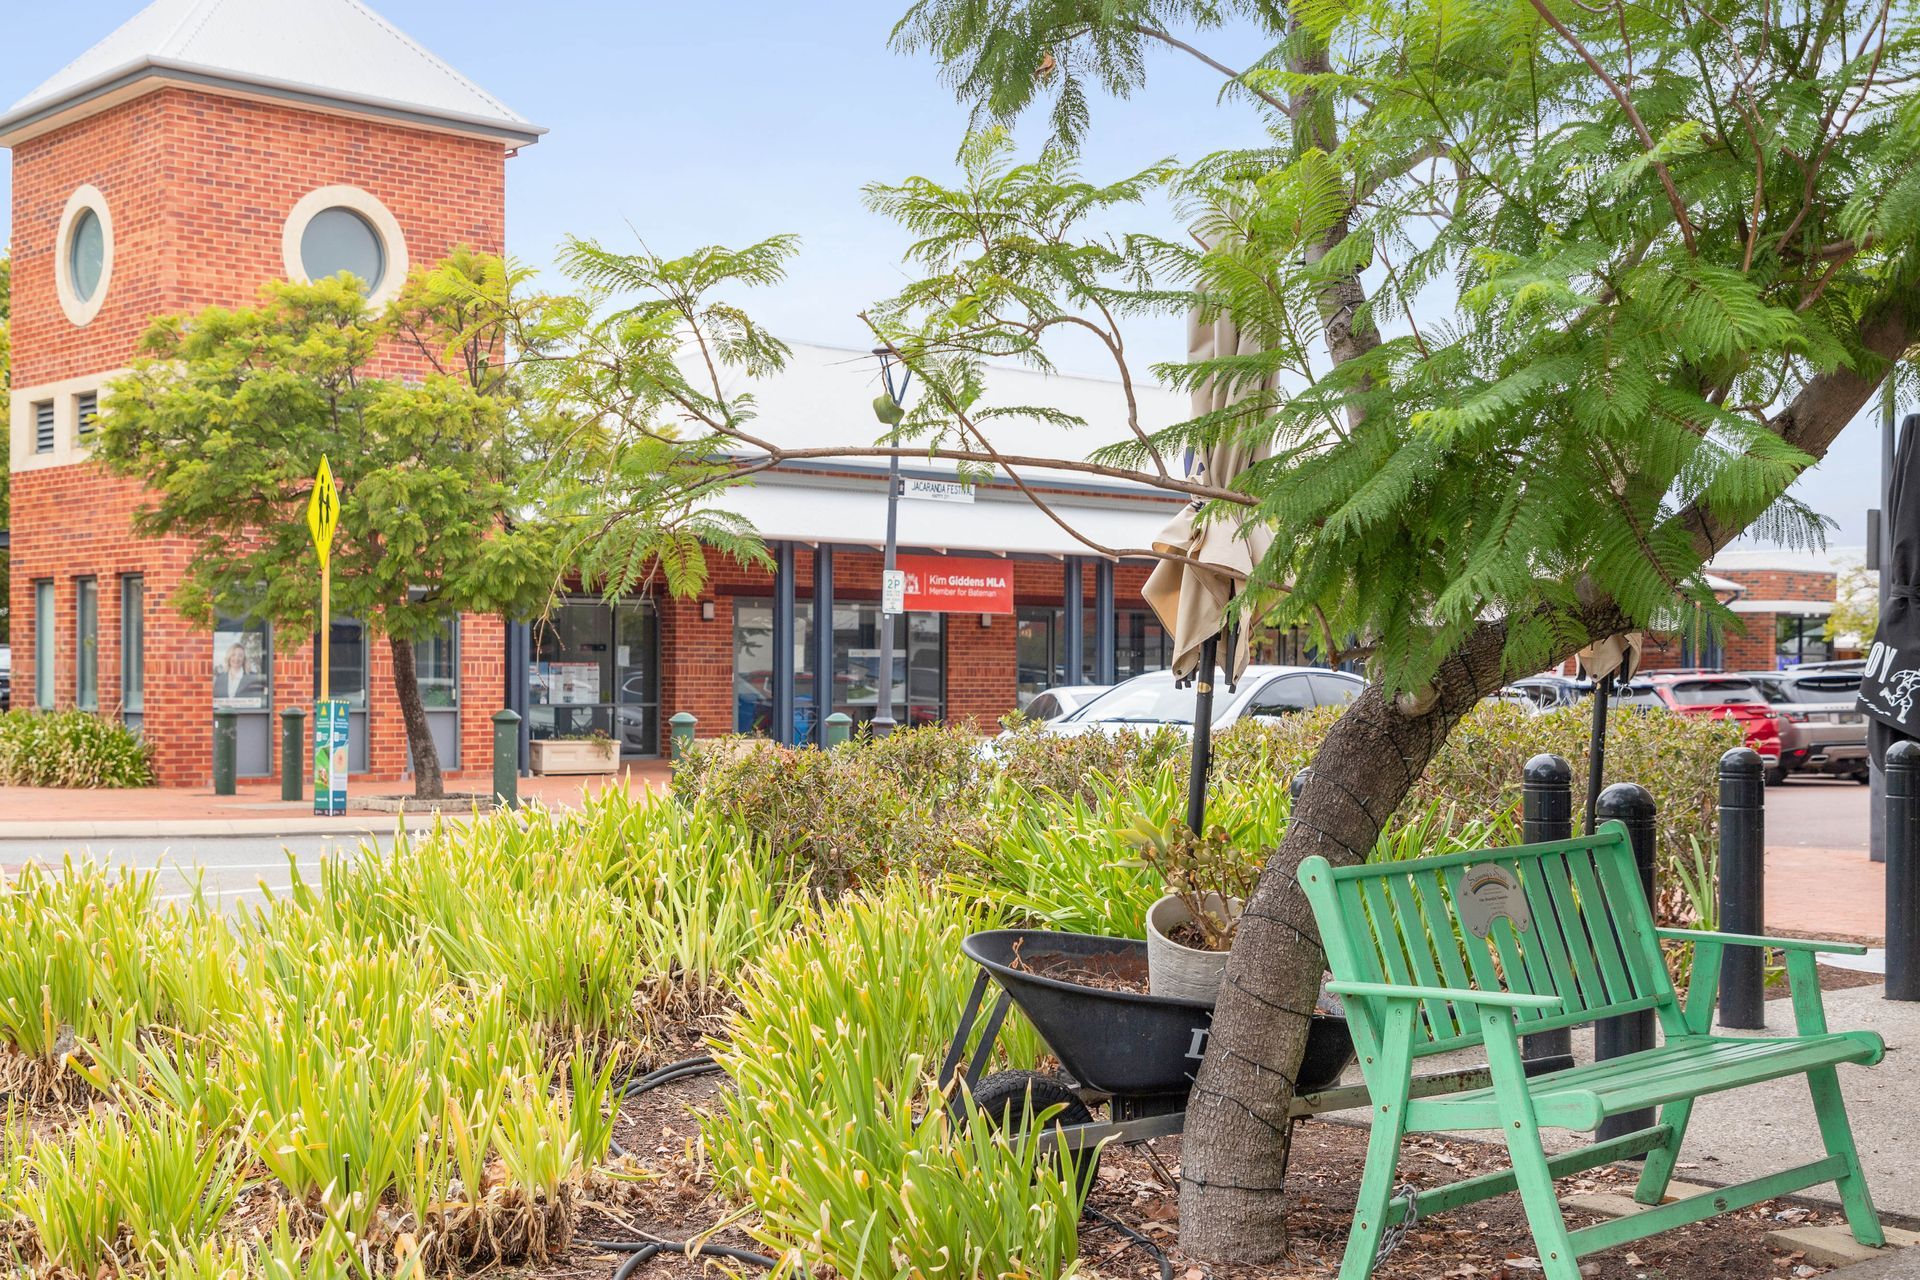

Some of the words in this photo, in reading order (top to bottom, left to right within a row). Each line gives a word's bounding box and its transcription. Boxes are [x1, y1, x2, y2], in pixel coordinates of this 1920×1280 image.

[912, 481, 946, 493] JACARANDA
[947, 484, 974, 496] FESTVAL
[887, 579, 901, 589] 2P
[929, 574, 947, 585] Kim
[948, 575, 985, 587] Giddens
[986, 577, 1006, 588] MLA
[929, 587, 956, 596] Member
[957, 588, 967, 597] for
[968, 588, 997, 597] Bateman
